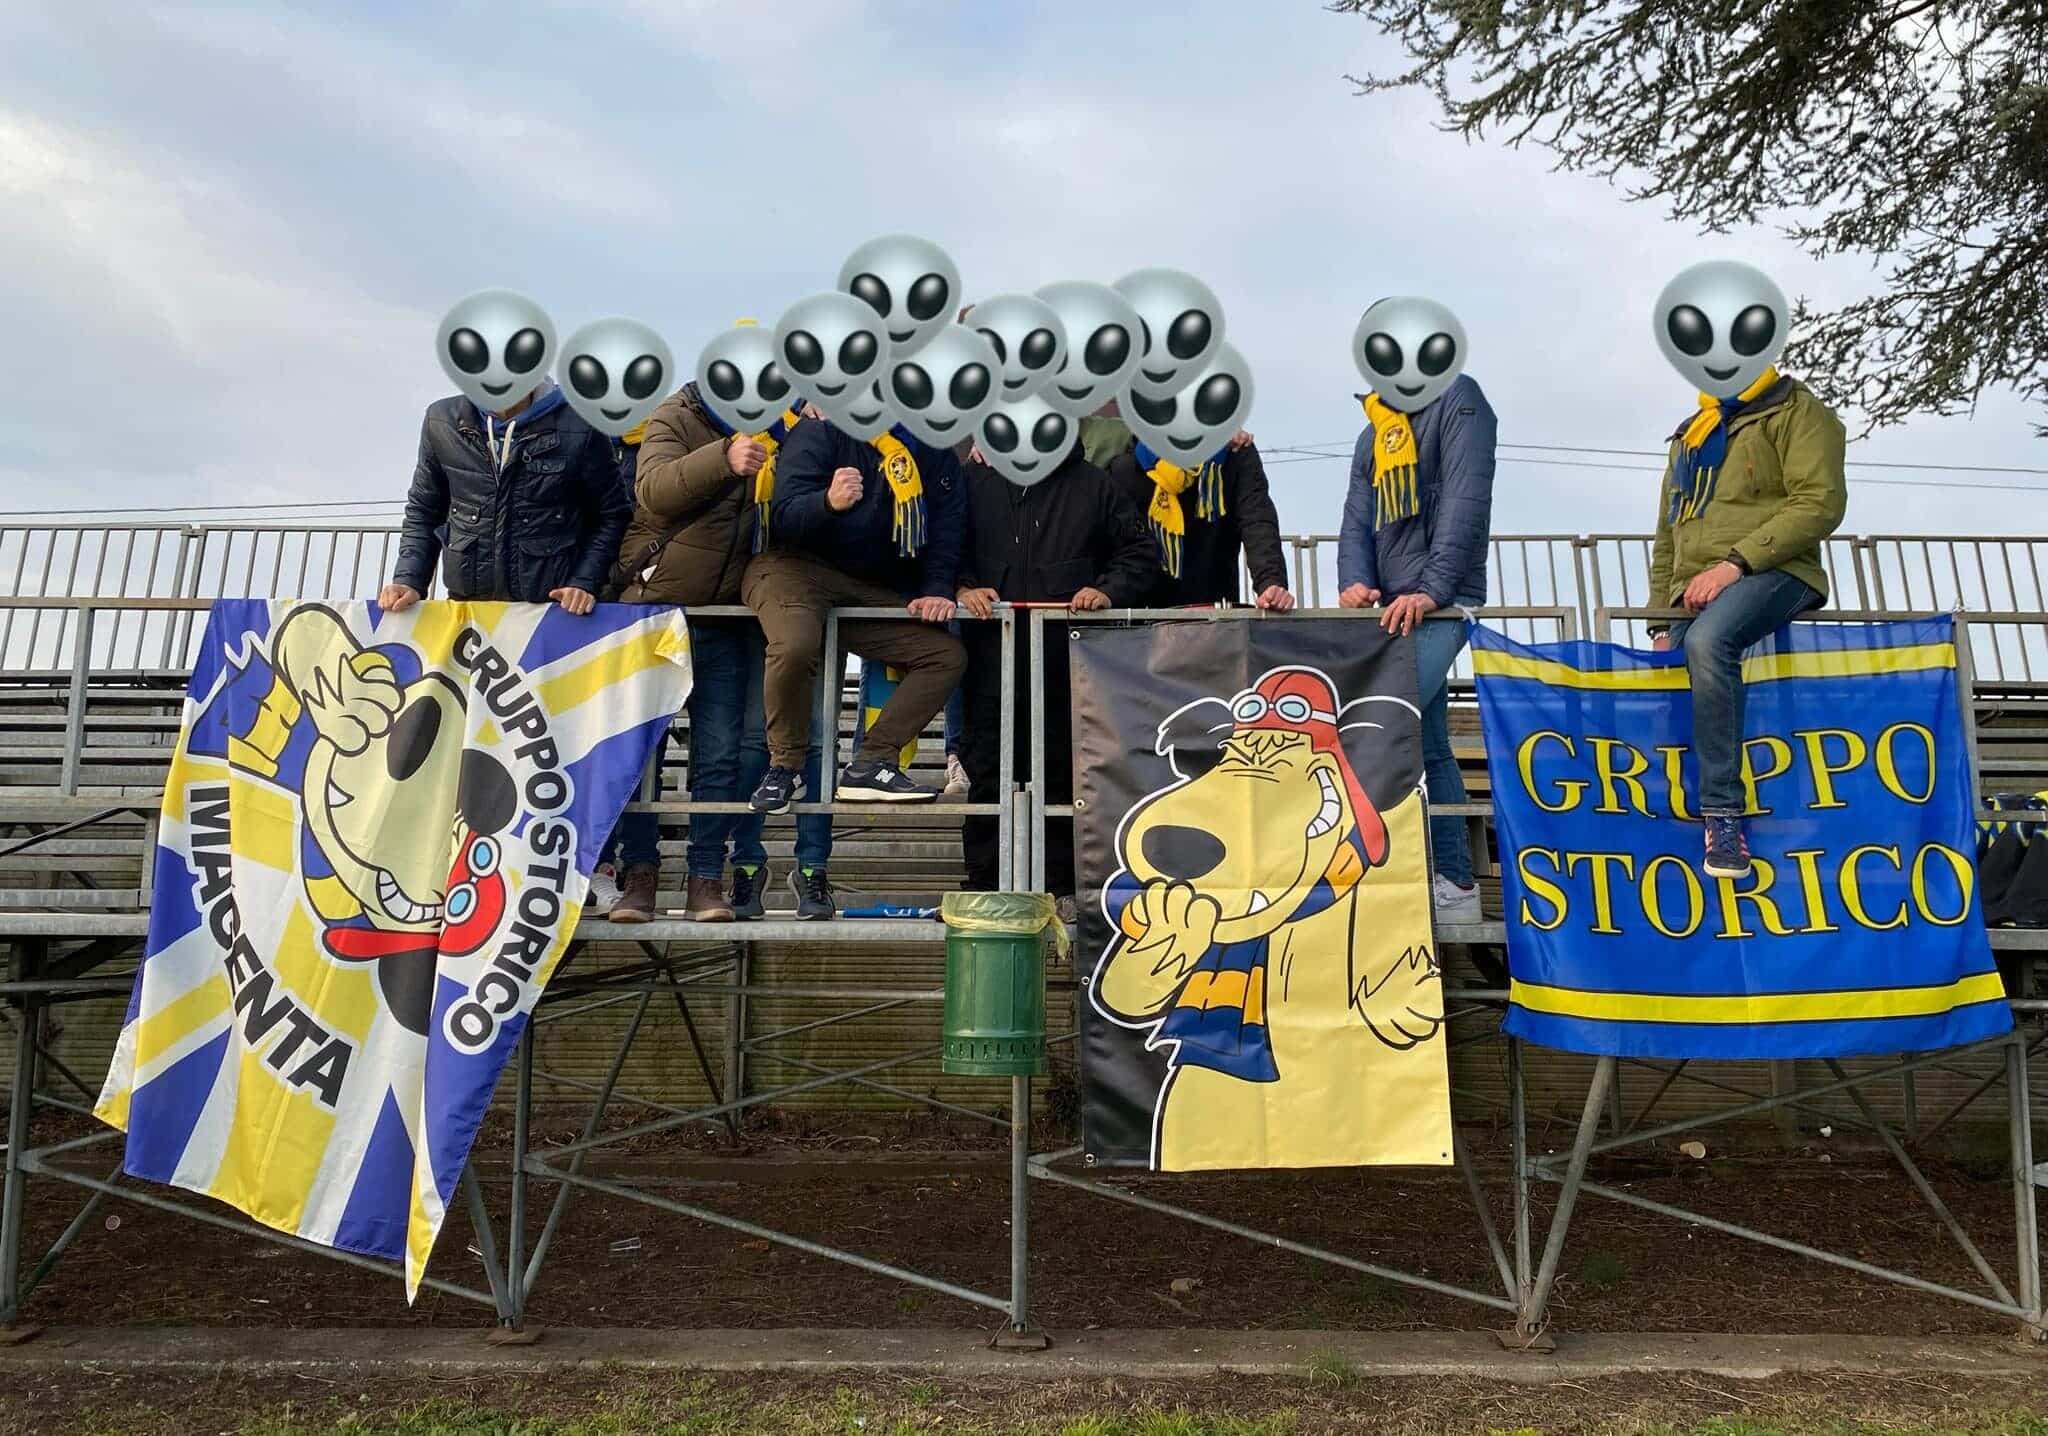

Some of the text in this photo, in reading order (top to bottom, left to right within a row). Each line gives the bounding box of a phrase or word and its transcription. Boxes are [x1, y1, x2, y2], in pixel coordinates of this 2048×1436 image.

[450, 627, 570, 1047] GRUPPO STORICO
[1515, 720, 1937, 822] GRUPPO
[189, 786, 353, 1109] MAGENTA
[1516, 841, 1974, 940] STORICO
